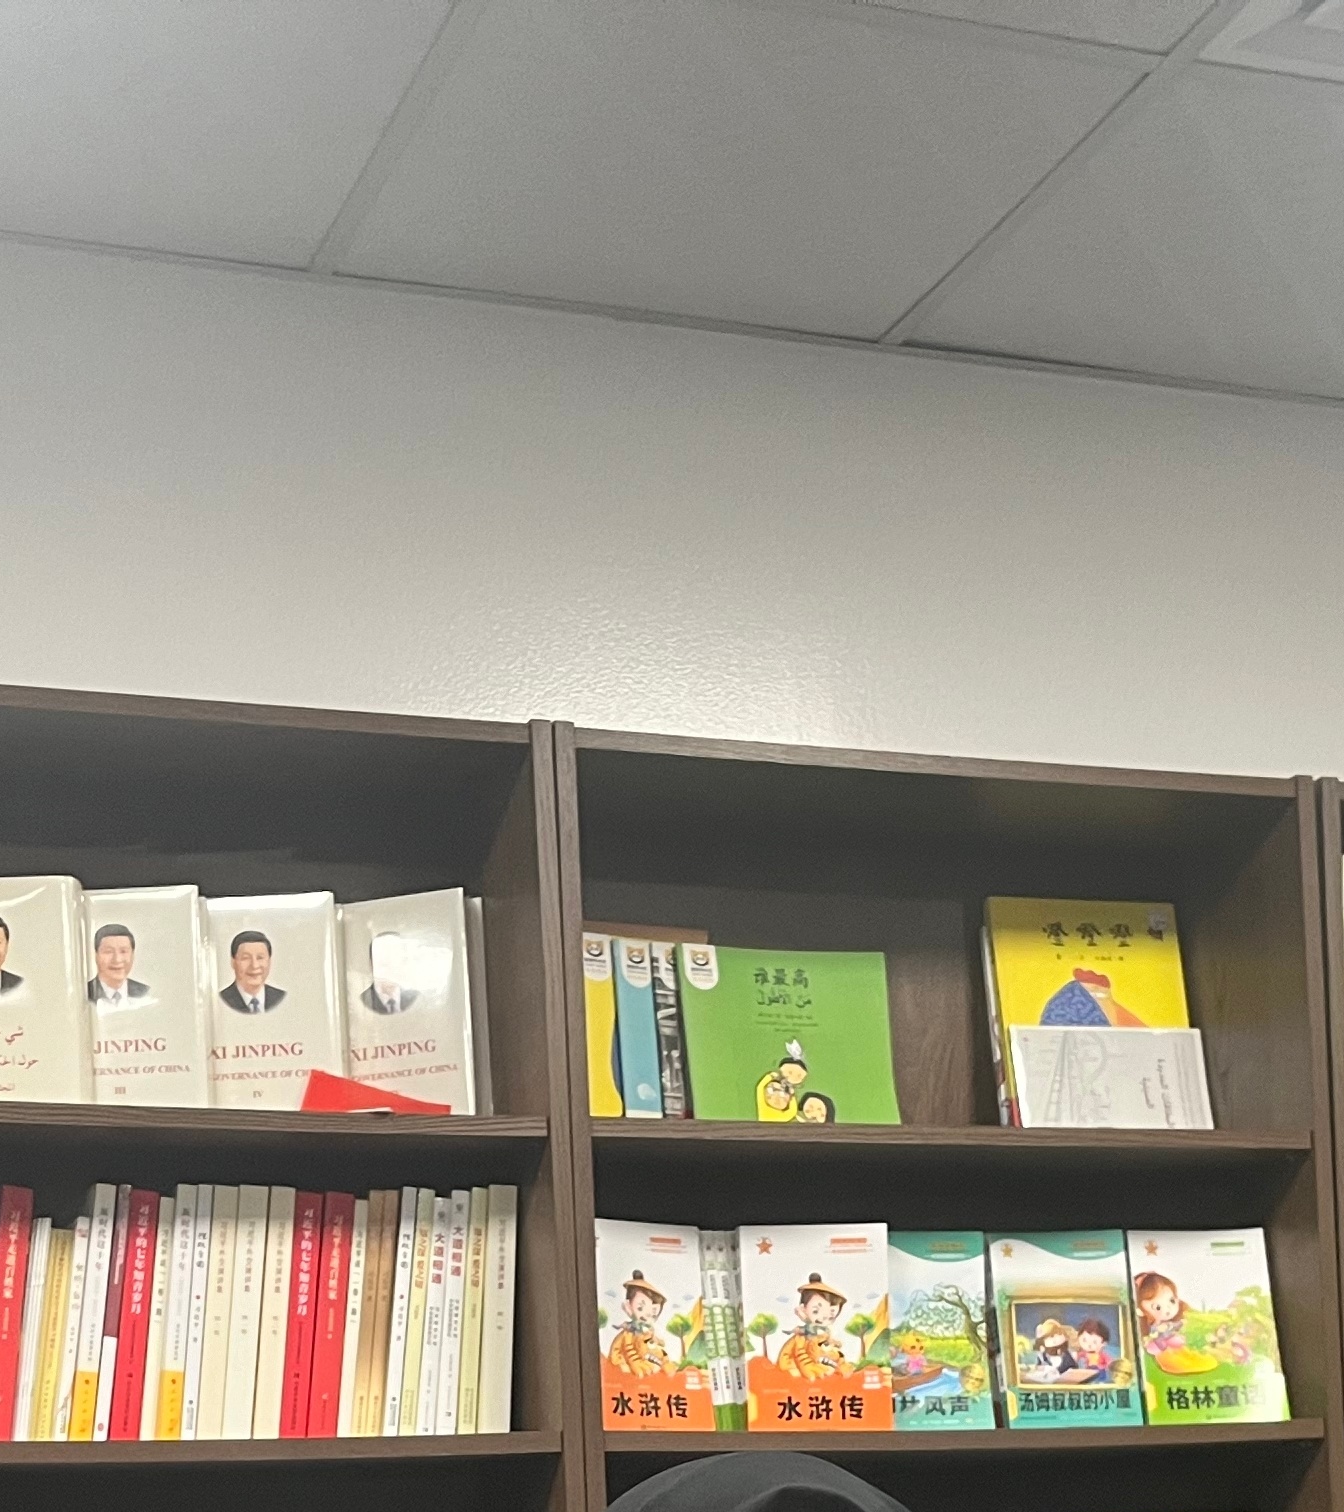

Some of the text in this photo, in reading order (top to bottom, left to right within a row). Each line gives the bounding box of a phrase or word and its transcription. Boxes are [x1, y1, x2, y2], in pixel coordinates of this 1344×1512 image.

[753, 967, 809, 989] 谁最高
[93, 1037, 167, 1055] JINPING
[231, 1041, 305, 1059] JINPING
[369, 1039, 437, 1060] JINPING
[141, 1065, 156, 1075] OF
[157, 1064, 191, 1075] CHINA
[279, 1068, 293, 1079] OF
[113, 1086, 127, 1096] III
[611, 1392, 689, 1419] 水浒传
[777, 1394, 864, 1421] 水浒传
[893, 1393, 971, 1417] 林风声
